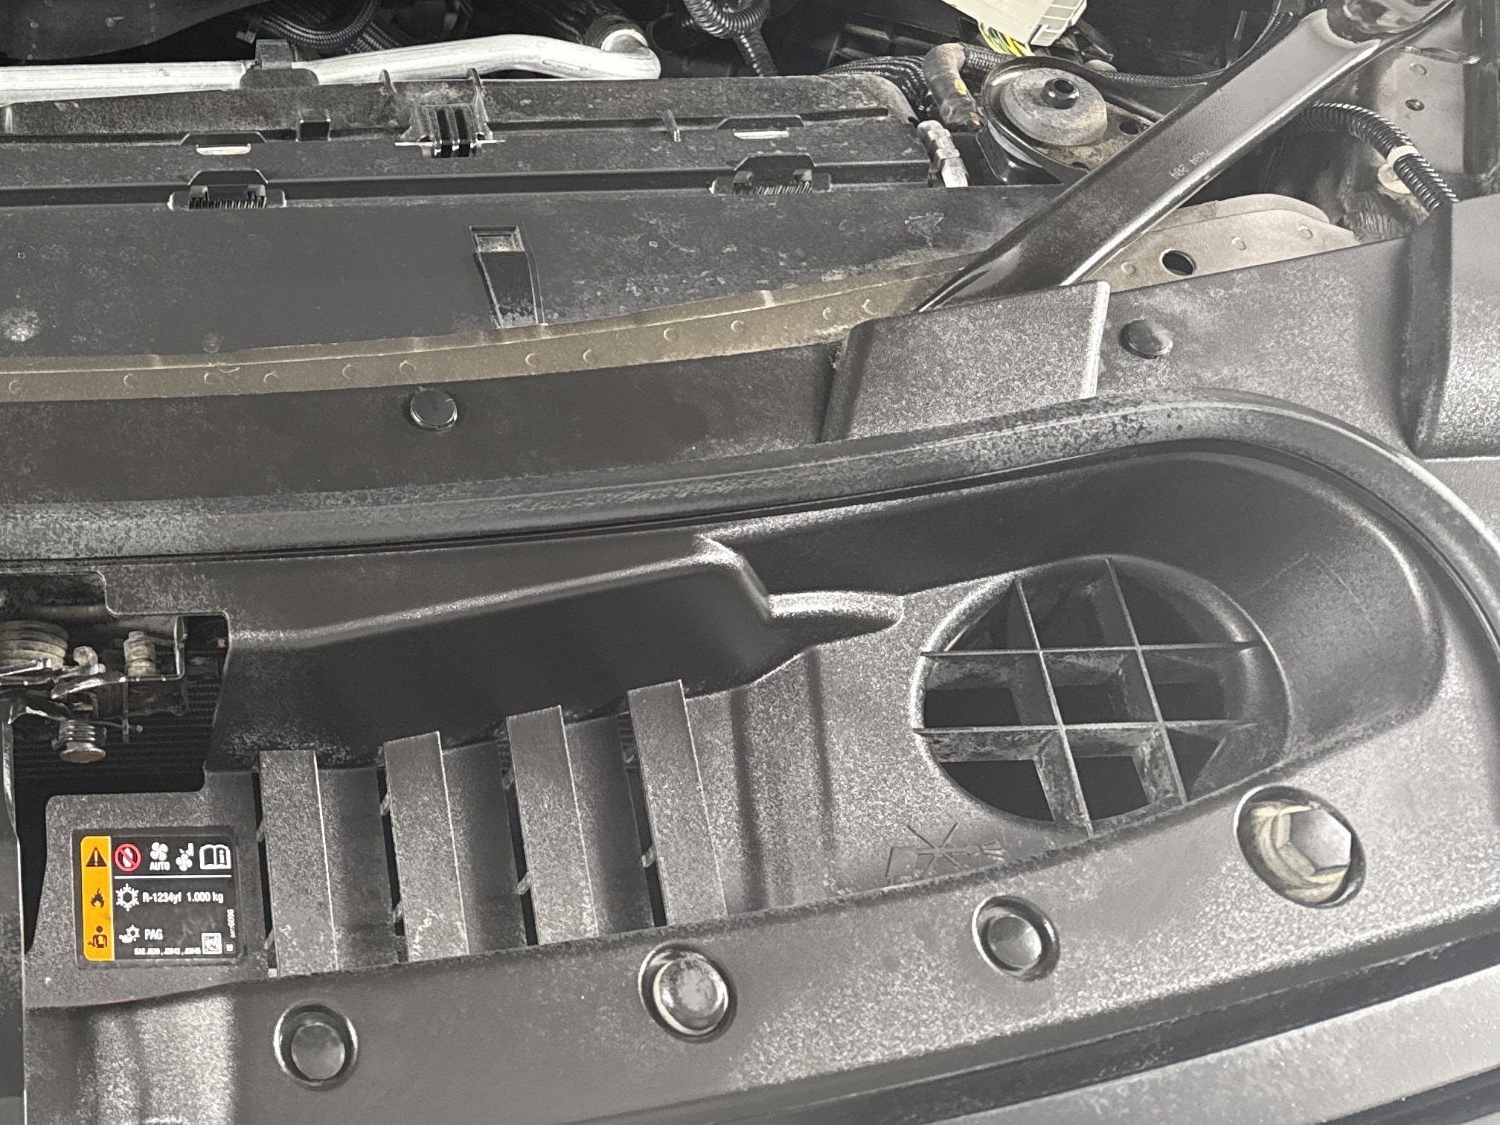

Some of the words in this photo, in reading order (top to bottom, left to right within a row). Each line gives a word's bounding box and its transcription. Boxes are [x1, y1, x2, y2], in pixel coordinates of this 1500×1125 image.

[149, 861, 171, 872] AUTO
[142, 892, 182, 905] R-1234yf
[186, 891, 211, 903] 1.000
[212, 892, 224, 904] kg
[144, 928, 163, 941] PAG
